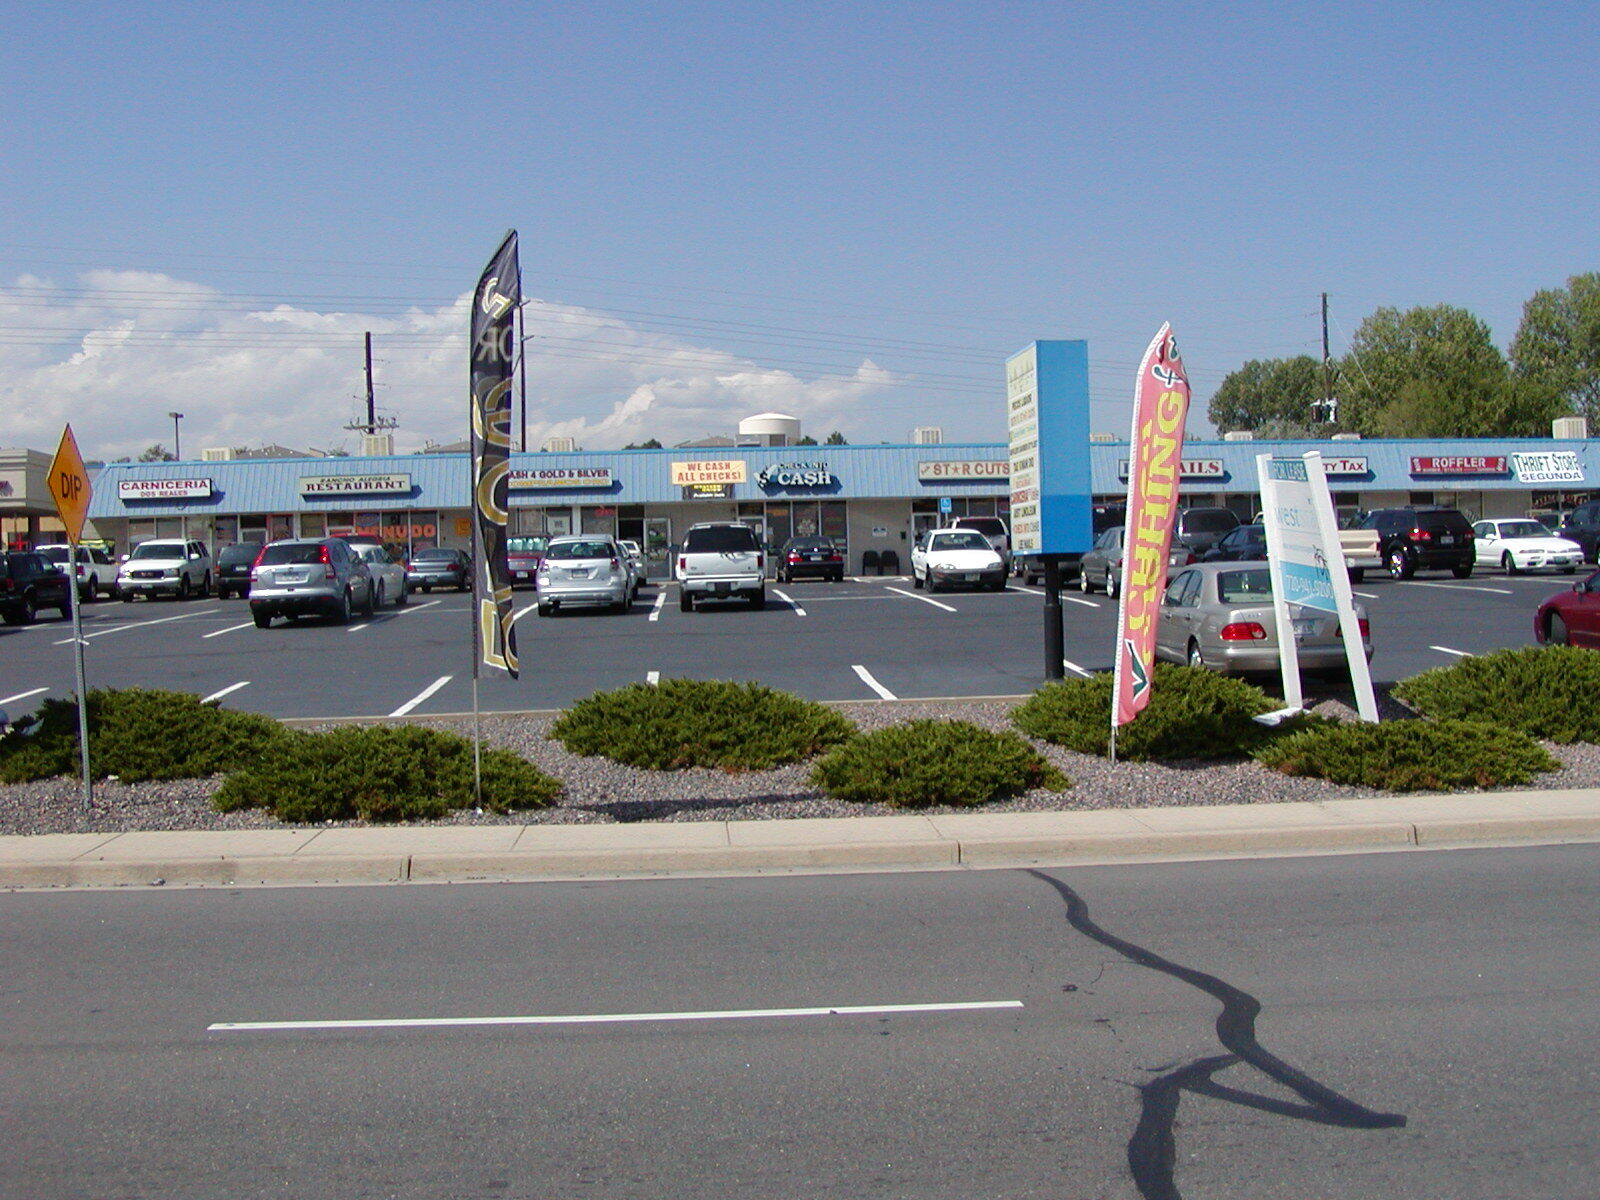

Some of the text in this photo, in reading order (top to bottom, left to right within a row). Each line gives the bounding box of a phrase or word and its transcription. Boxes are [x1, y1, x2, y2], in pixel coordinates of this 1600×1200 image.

[687, 462, 731, 471] WE CASH
[1432, 457, 1486, 468] ROFFLER
[1513, 454, 1550, 472] THRIFT
[509, 470, 528, 479] ASH
[540, 470, 566, 478] GOLD
[577, 469, 609, 478] SILVER
[974, 463, 1010, 475] CUTS
[677, 471, 741, 482] ALL CHECKS!
[1522, 472, 1581, 481] SEGUNDA
[61, 472, 82, 501] DIP
[121, 480, 208, 491] CARNICERIA
[306, 480, 405, 491] RESTAURANT
